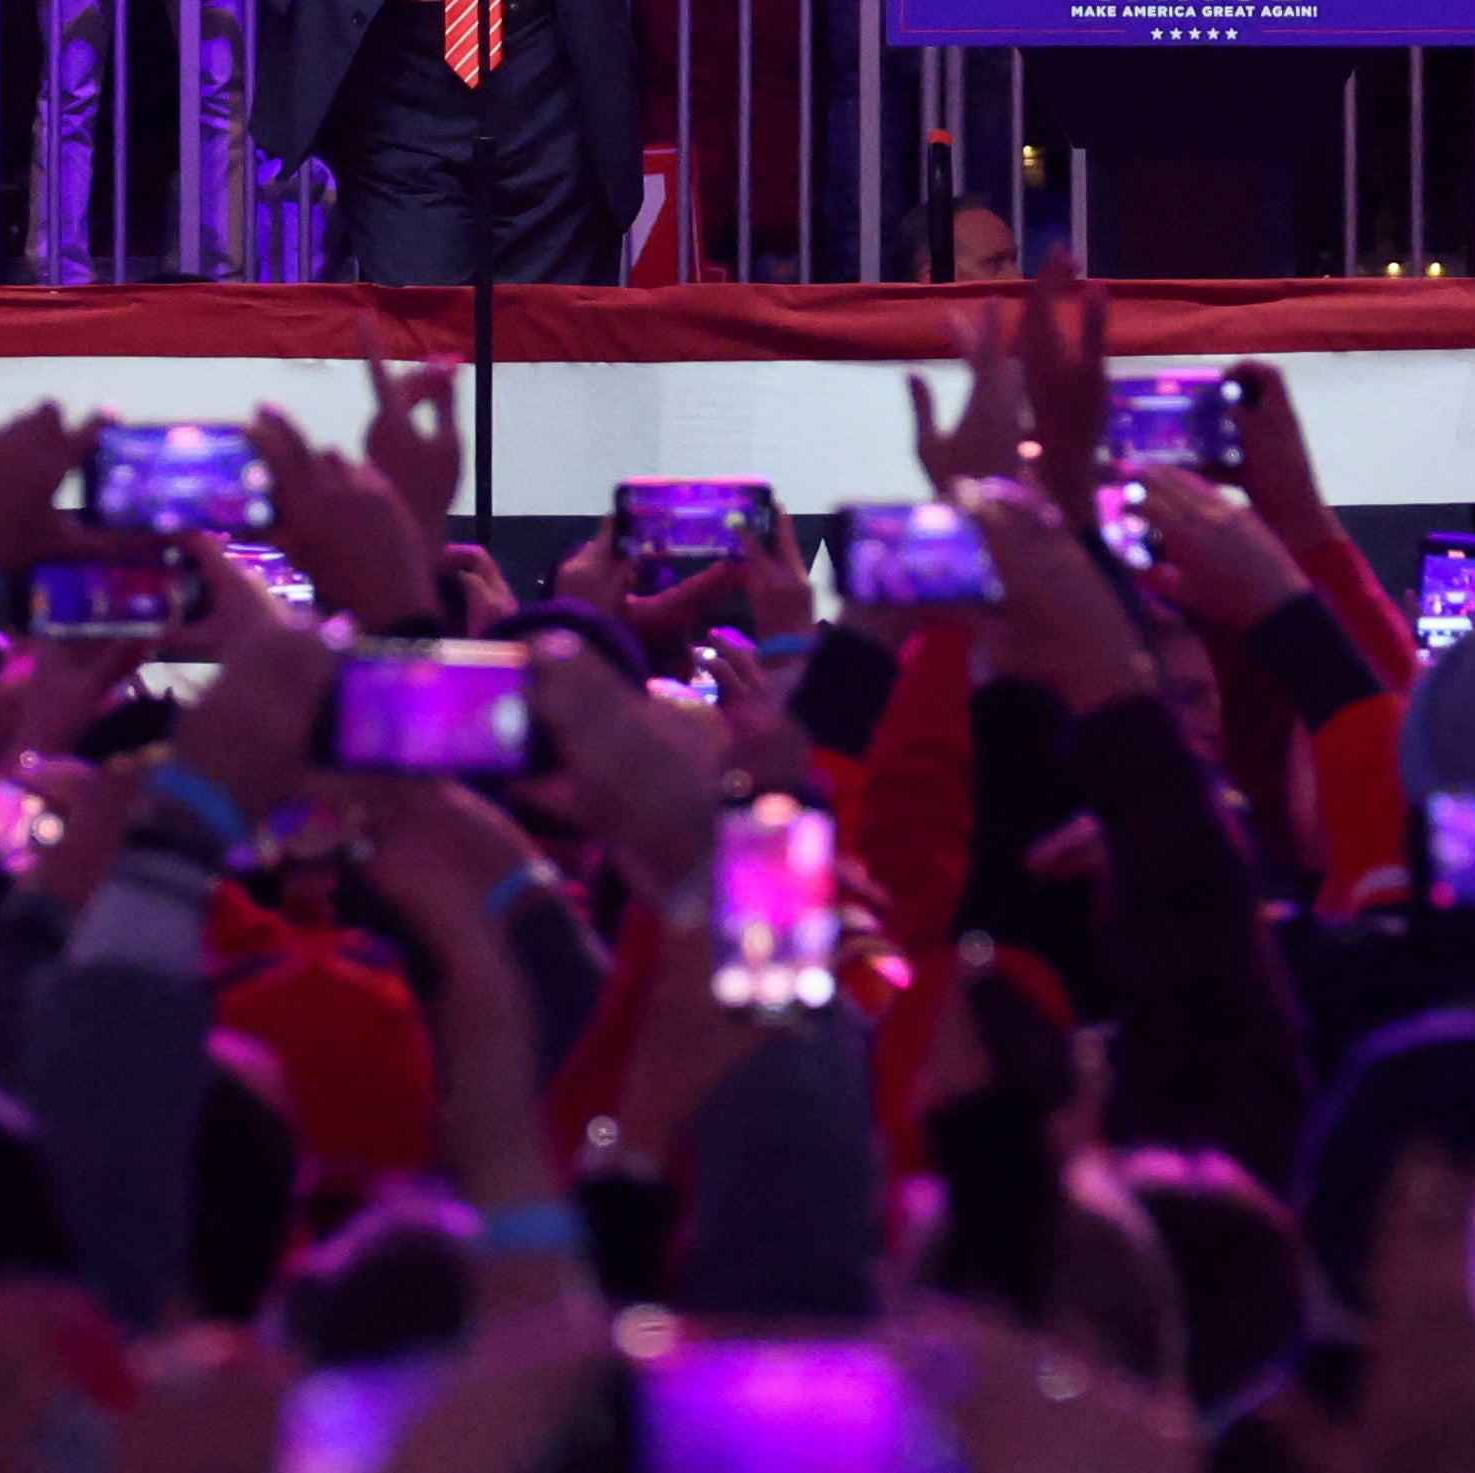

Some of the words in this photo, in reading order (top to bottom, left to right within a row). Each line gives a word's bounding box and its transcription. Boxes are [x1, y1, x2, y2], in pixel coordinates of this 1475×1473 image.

[1071, 5, 1116, 18] MAKE
[1122, 5, 1196, 18] AMERICA
[1202, 5, 1255, 18] GREAT
[1261, 5, 1318, 18] AGAIN!
